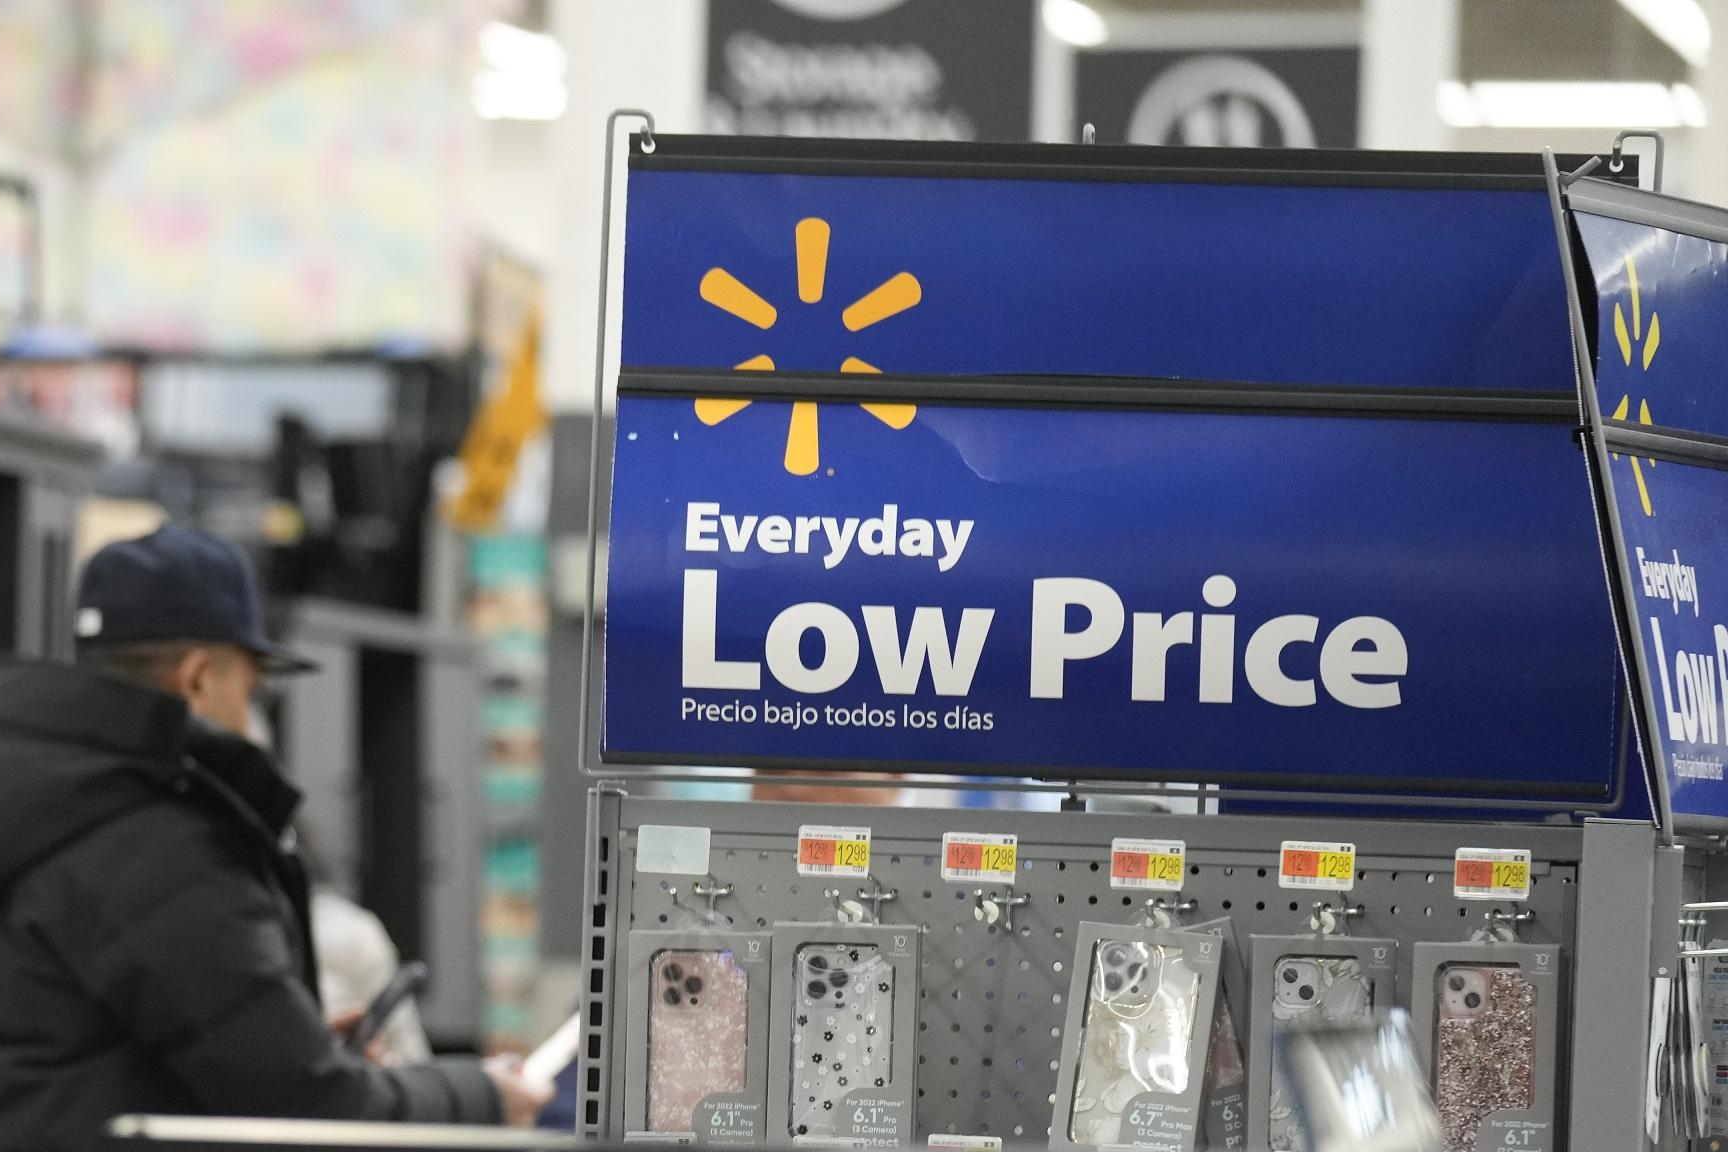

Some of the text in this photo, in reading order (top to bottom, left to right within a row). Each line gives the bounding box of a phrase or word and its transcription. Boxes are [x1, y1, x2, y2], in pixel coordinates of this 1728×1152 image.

[685, 501, 975, 572] Everyday
[1635, 546, 1700, 618] Everyday
[681, 568, 1409, 709] Low Price
[1650, 616, 1719, 745] Low
[681, 698, 994, 731] Precio bajo todos los días
[740, 1119, 754, 1127] Pro
[884, 1116, 897, 1124] Pro
[1161, 1121, 1175, 1129] Pro
[1176, 1122, 1193, 1131] Max
